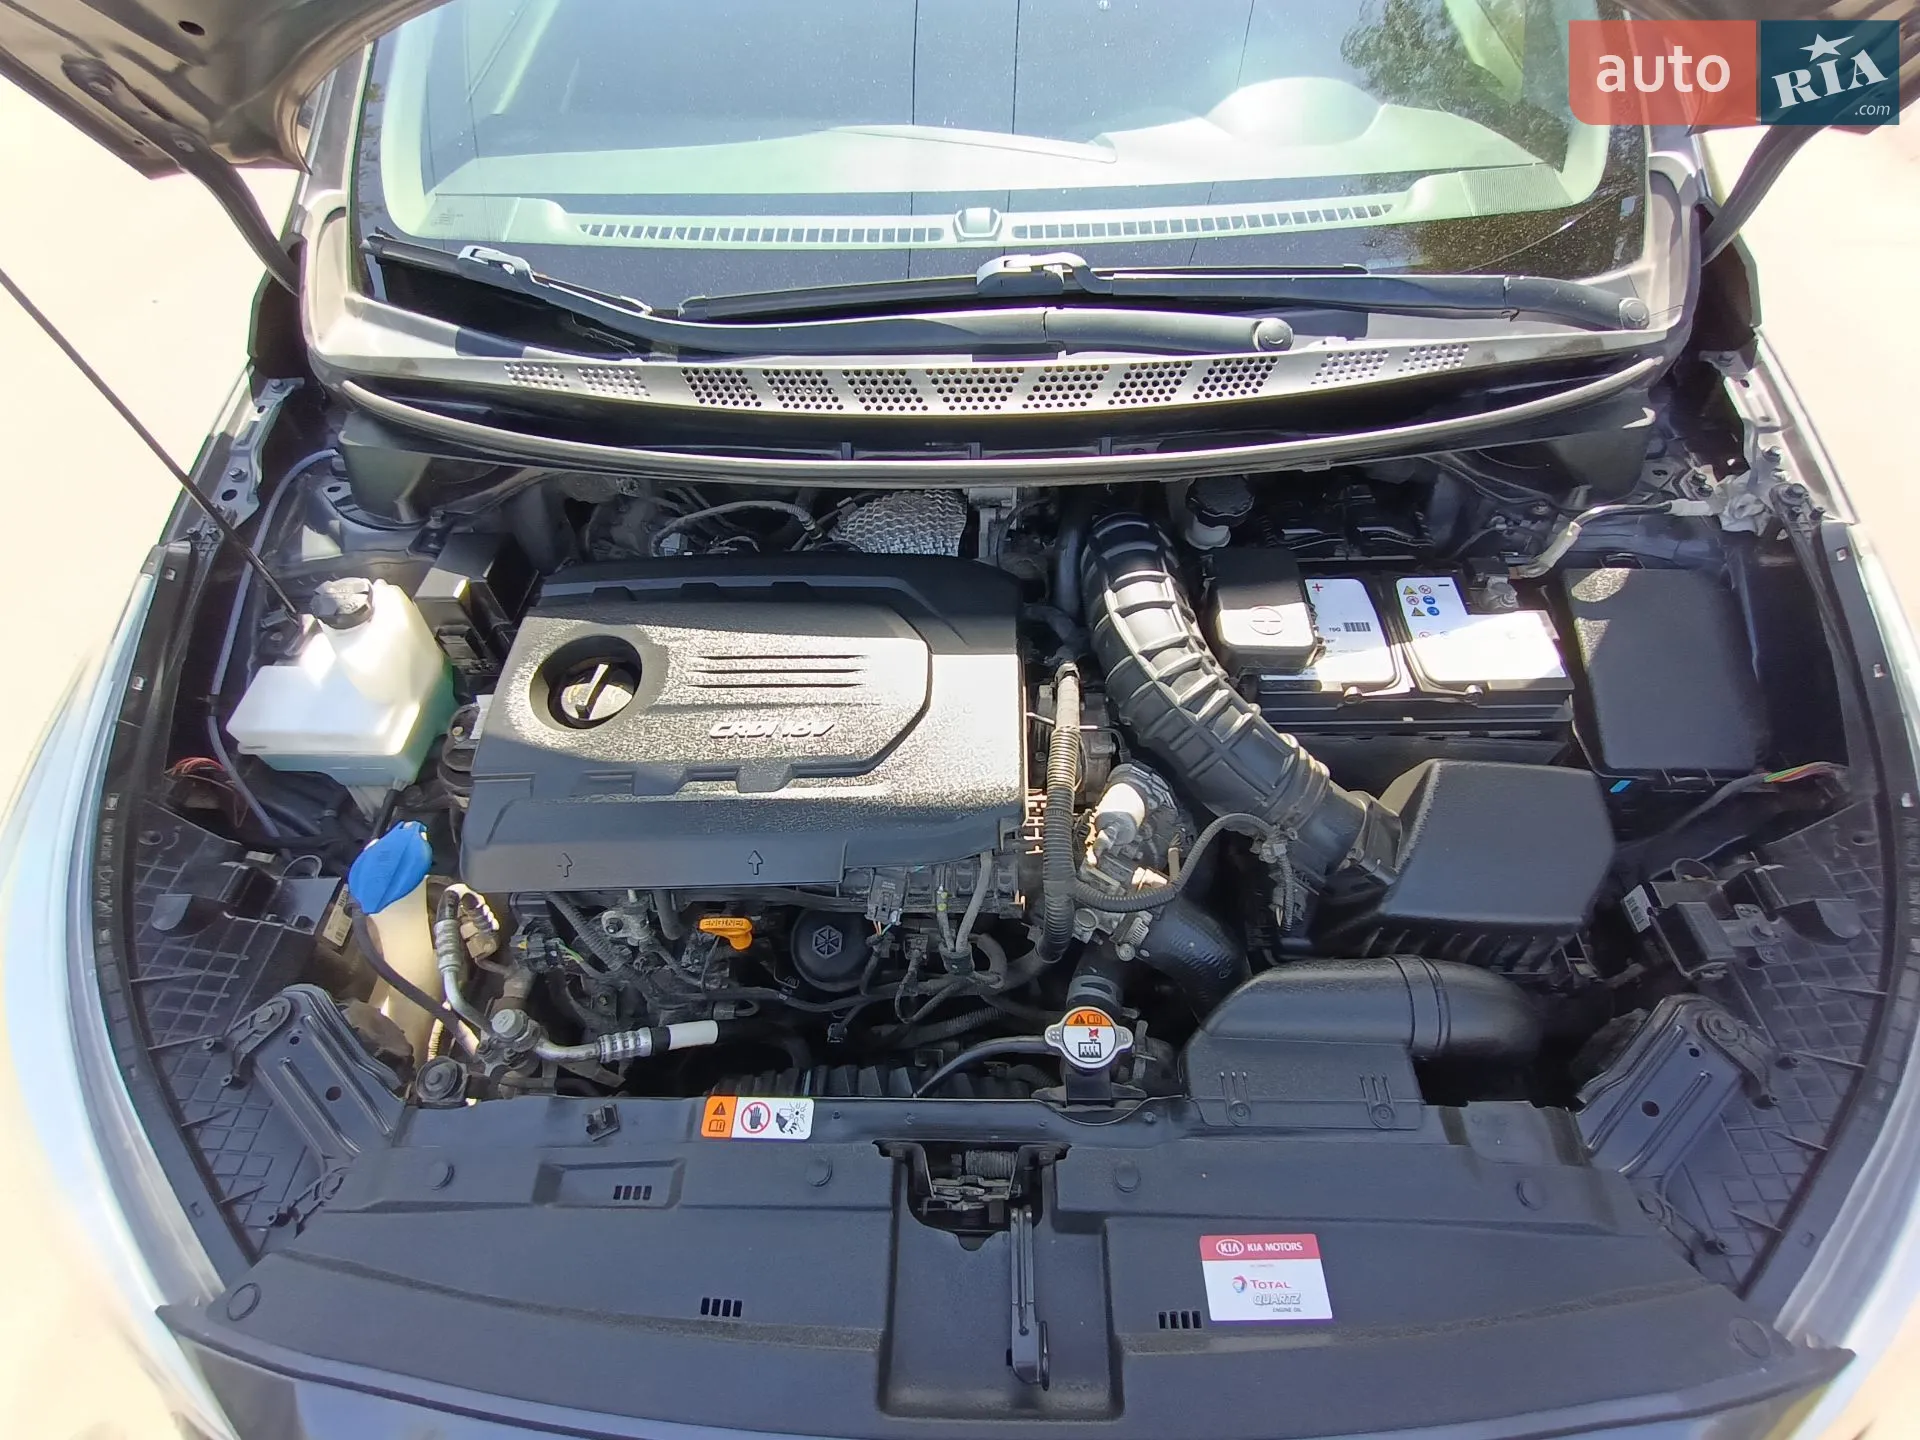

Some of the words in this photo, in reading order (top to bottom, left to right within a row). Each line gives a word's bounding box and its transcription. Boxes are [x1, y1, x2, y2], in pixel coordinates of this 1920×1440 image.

[1220, 1243, 1240, 1253] KIA
[1247, 1243, 1263, 1252] KIA
[1264, 1242, 1303, 1252] MOTORS
[1253, 1292, 1301, 1306] QUARTZ
